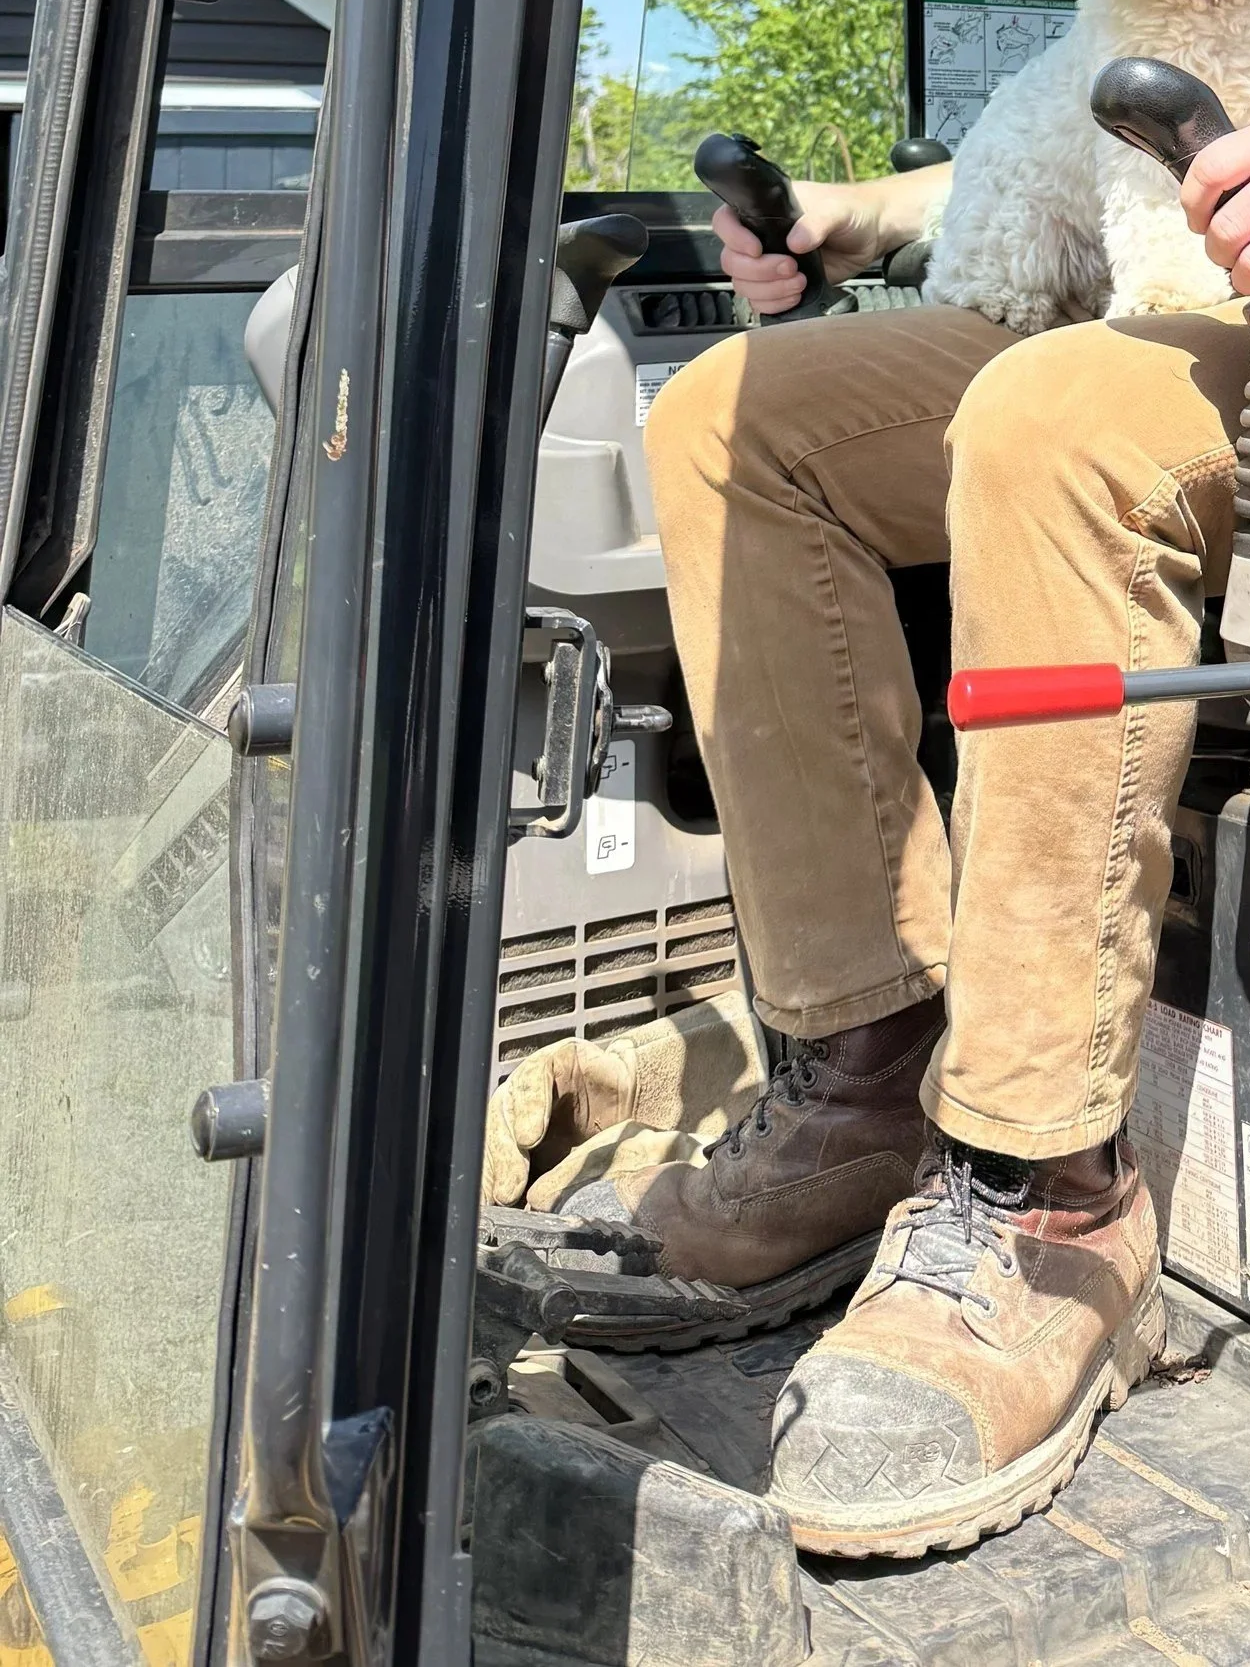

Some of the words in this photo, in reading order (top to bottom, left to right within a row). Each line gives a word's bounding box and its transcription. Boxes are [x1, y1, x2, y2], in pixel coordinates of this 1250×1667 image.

[1160, 1005, 1176, 1019] LOAD
[1179, 1012, 1200, 1029] RATING
[1203, 1023, 1223, 1039] CHART
